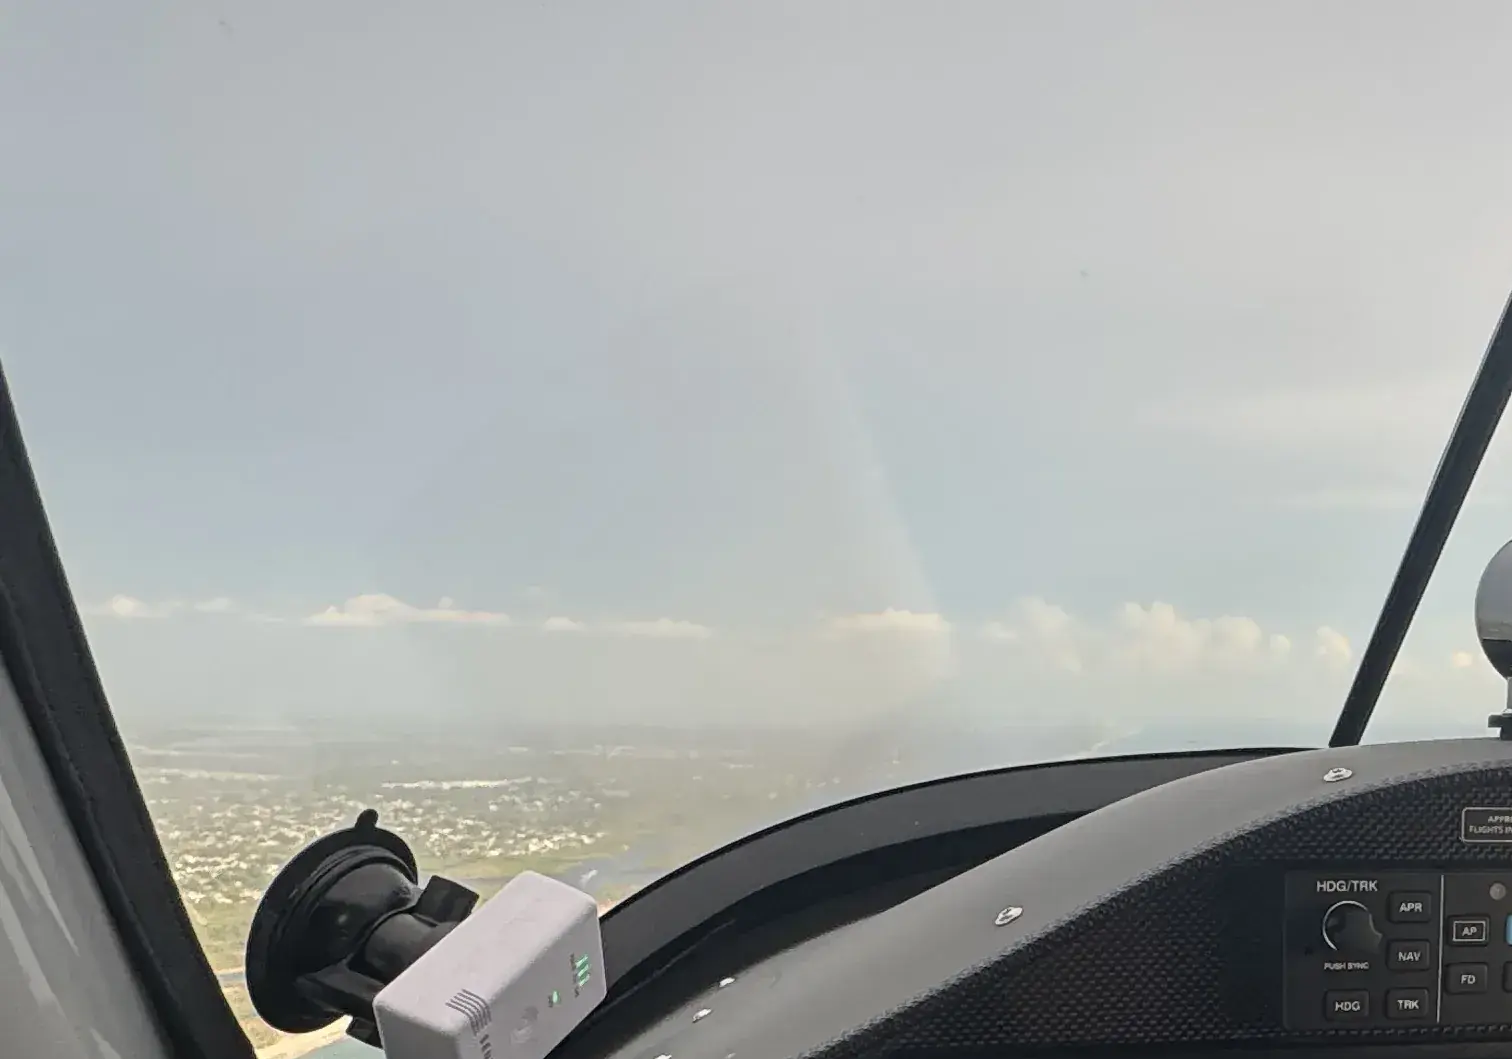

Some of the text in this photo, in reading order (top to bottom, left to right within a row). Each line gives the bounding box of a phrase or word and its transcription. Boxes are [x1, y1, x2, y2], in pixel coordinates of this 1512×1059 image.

[1316, 880, 1378, 892] HDG/TRK
[1399, 902, 1422, 913] APR
[1462, 926, 1477, 936] AP
[1398, 951, 1421, 961] NAV
[1324, 962, 1369, 970] PUSH SYNC
[1461, 974, 1476, 984] FD
[1335, 1001, 1360, 1011] HDG
[1397, 999, 1419, 1010] TRK
